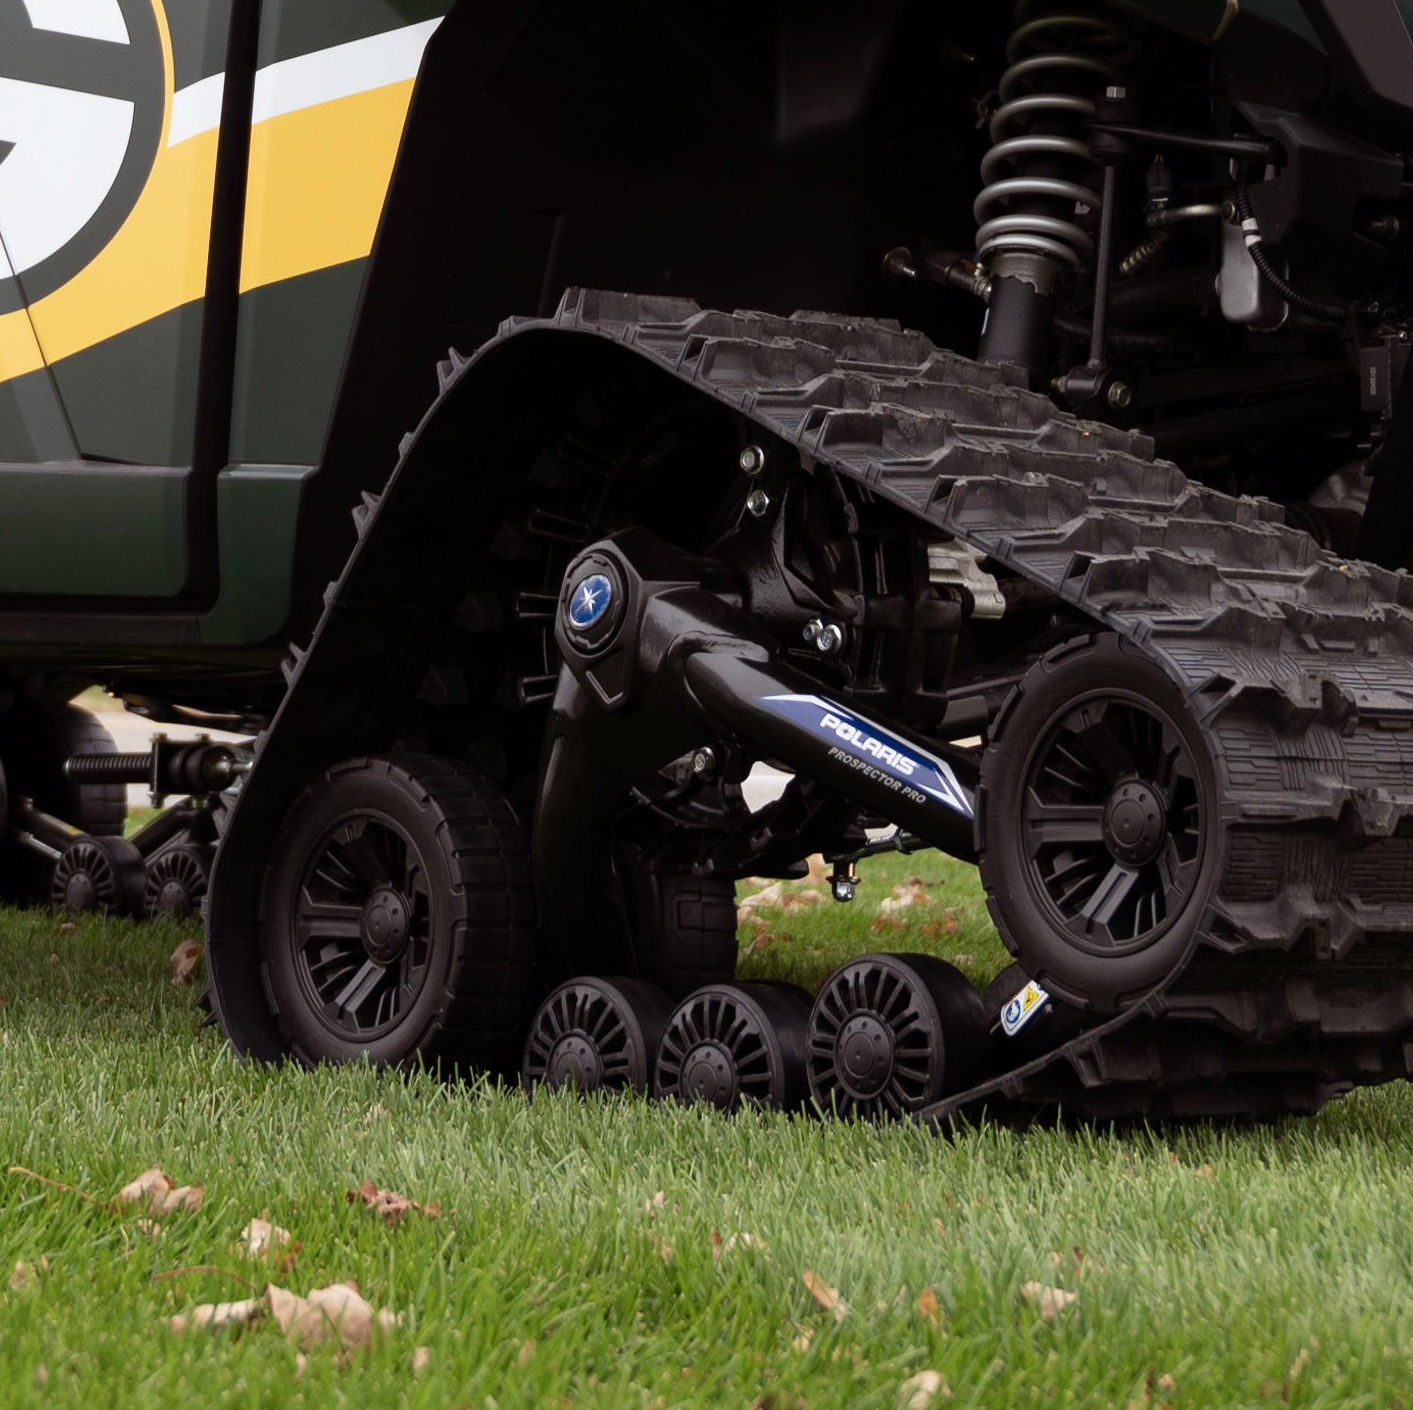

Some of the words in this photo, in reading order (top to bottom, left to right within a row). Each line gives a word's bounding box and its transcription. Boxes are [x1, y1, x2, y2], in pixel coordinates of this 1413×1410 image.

[819, 712, 917, 776] POLARIS
[827, 746, 902, 791] PROSPECTOR
[900, 785, 927, 804] PRO
